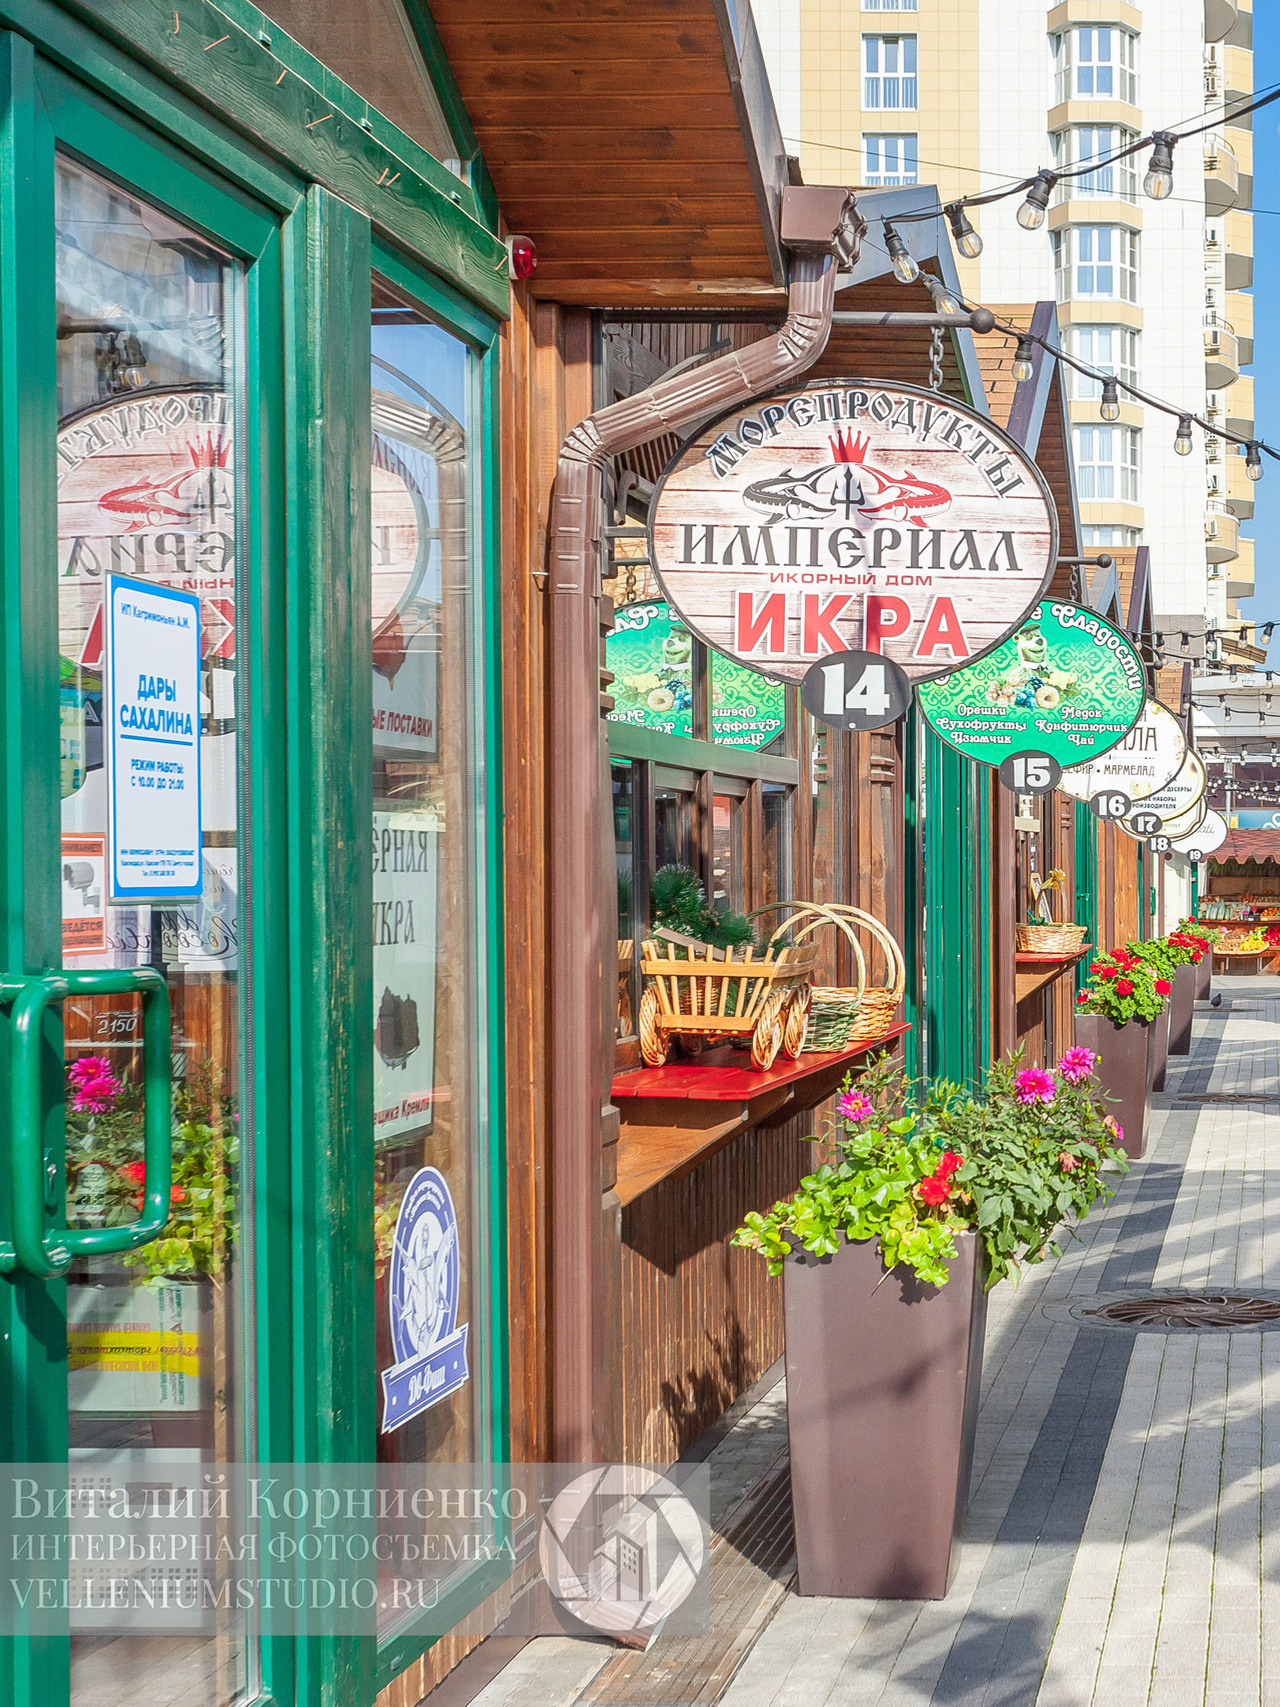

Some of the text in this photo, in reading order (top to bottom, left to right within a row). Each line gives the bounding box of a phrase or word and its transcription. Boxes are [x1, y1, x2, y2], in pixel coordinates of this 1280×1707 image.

[706, 391, 1025, 499] МОРЕПРОДУКТЫ
[678, 523, 1023, 571] ИМПЕРИАЛ
[770, 571, 933, 587] ИКОРНЫЙ ДОМ
[736, 591, 971, 658] ИКРА
[1050, 603, 1144, 691] Сладости
[137, 674, 176, 702] ДАРЫ
[820, 662, 891, 717] 14
[120, 704, 193, 736] САХАЛИНА
[957, 703, 1102, 719] Орешки Медок
[386, 711, 433, 738] ПОСТАВКИ
[936, 717, 1128, 733] Сухофрукты Конфитюрчик
[950, 731, 1095, 747] Изюмчик Чай
[131, 758, 155, 771] РЕЖИМ
[1012, 757, 1051, 788] 15
[1103, 764, 1155, 777] МАРМЕЛАД
[157, 778, 167, 790] ДО
[1097, 795, 1126, 817] 16
[1137, 815, 1157, 832] 17
[1150, 837, 1168, 851] 18
[1189, 850, 1201, 860] 19
